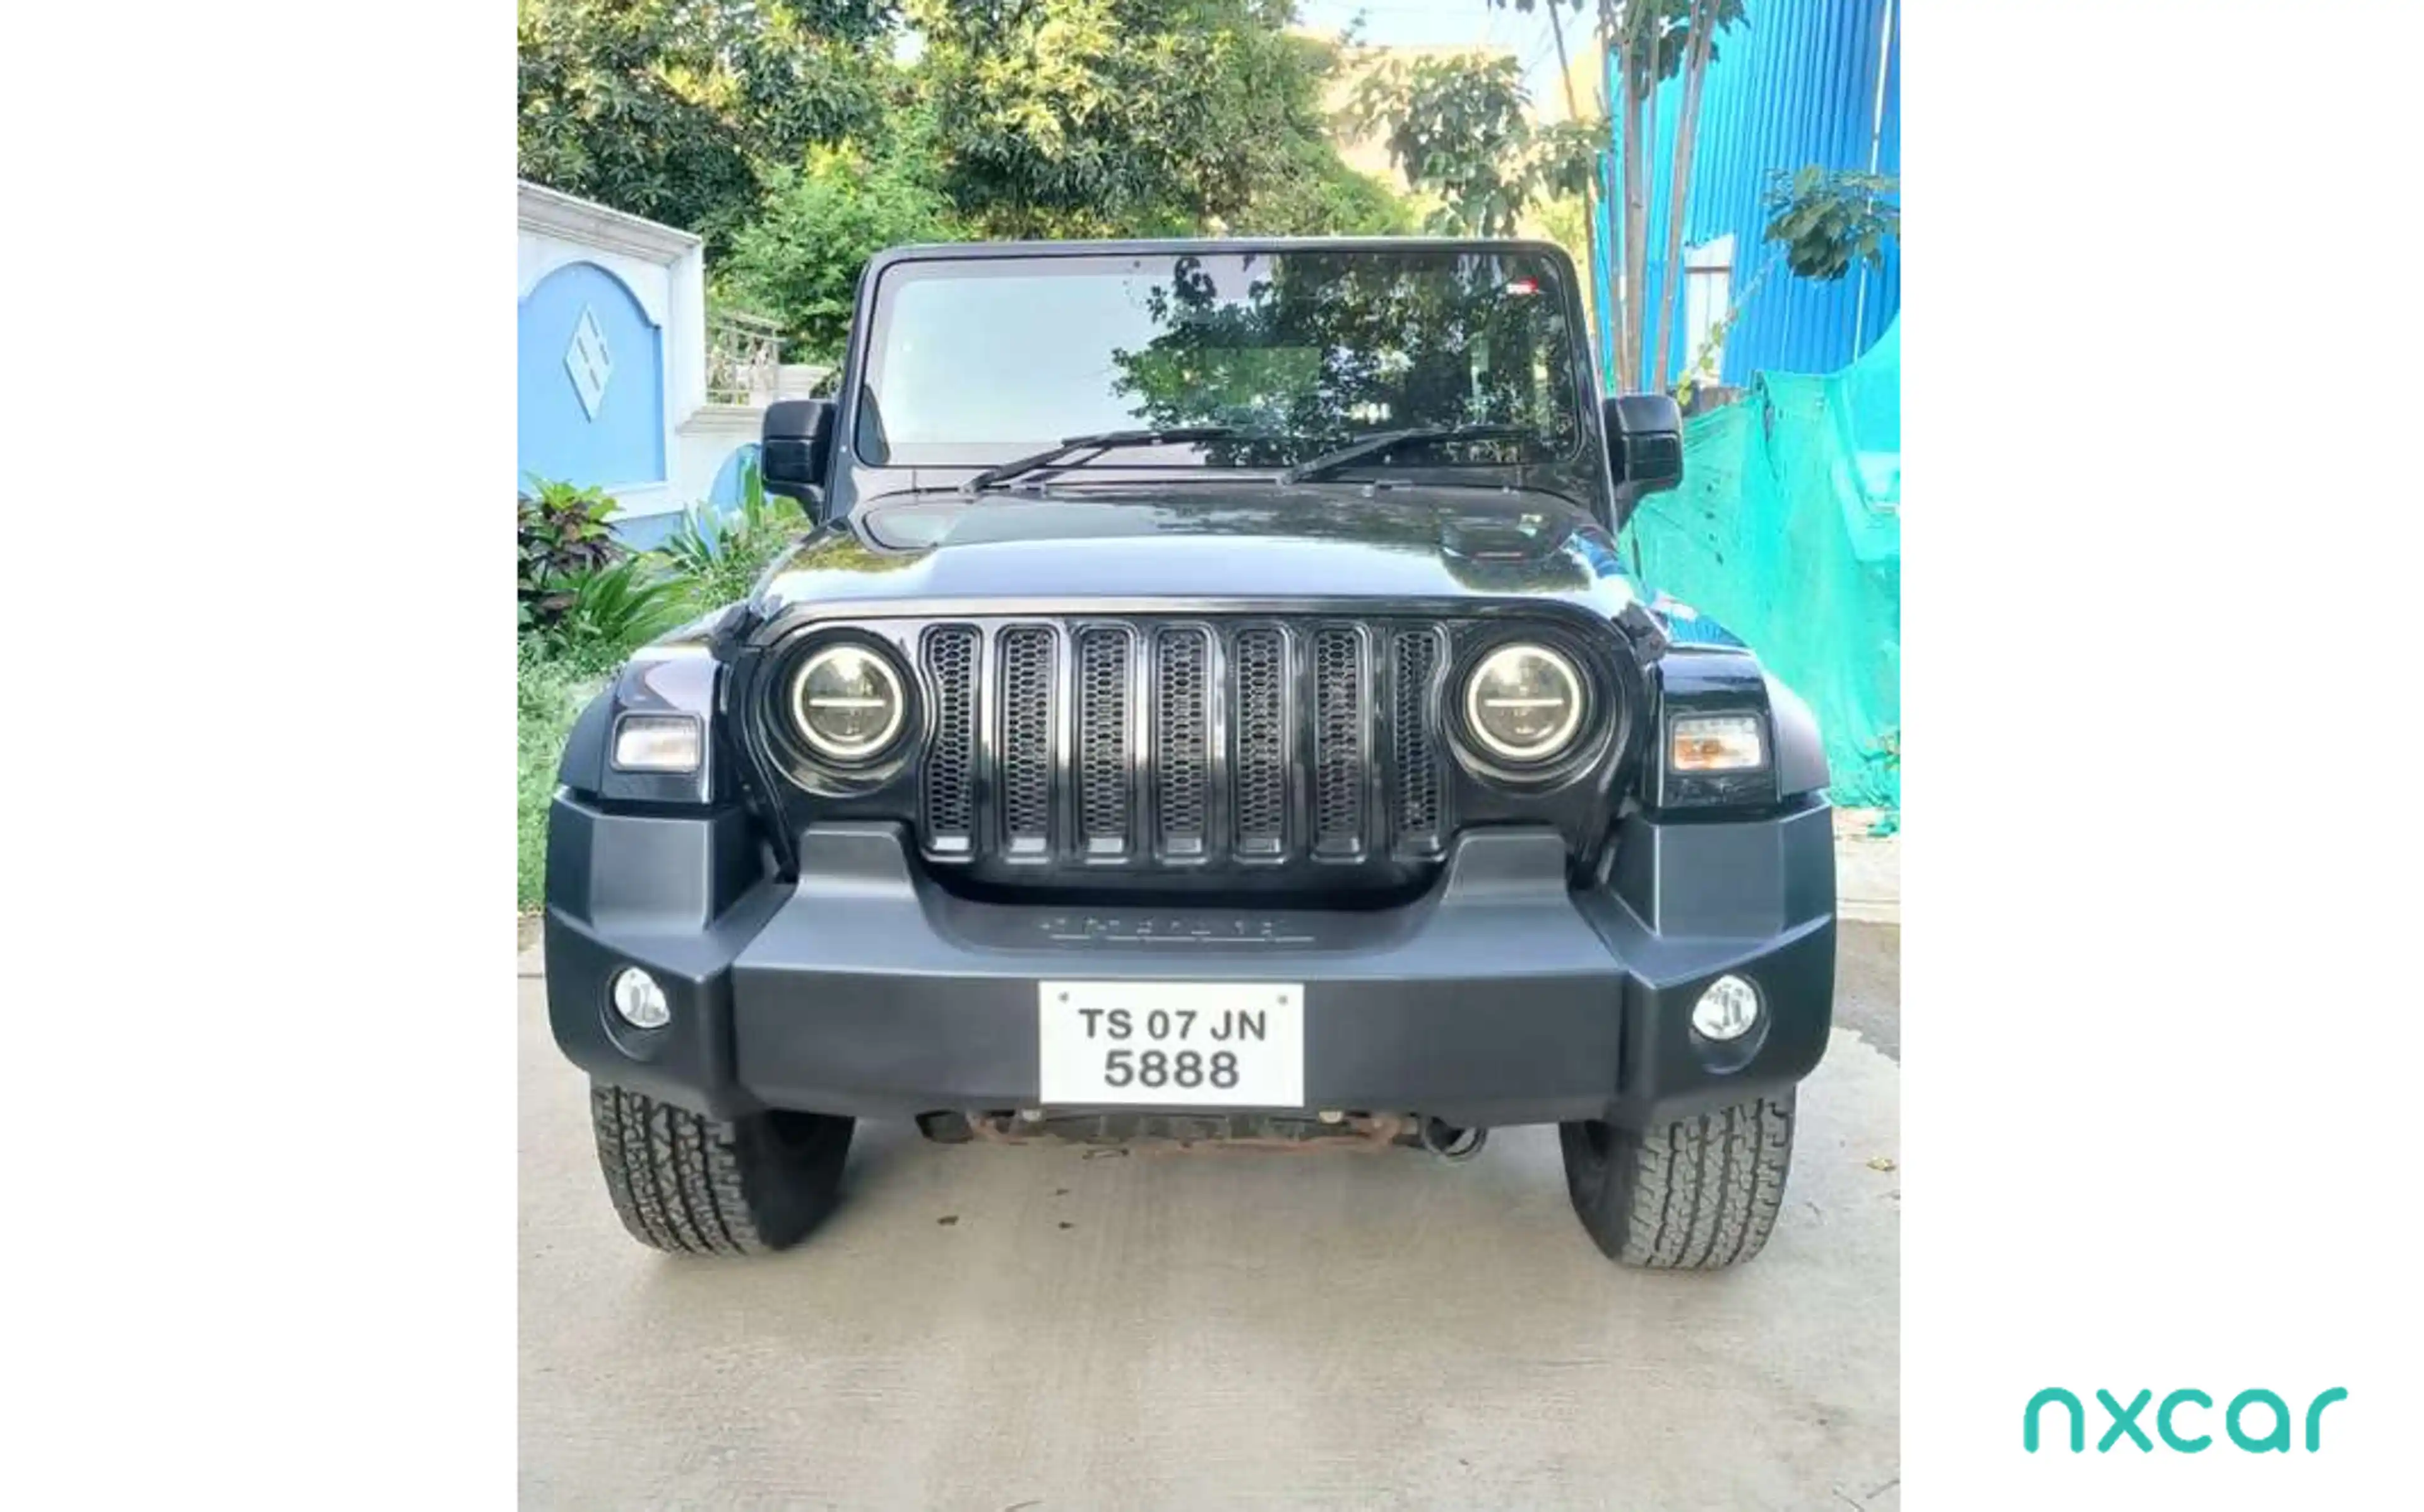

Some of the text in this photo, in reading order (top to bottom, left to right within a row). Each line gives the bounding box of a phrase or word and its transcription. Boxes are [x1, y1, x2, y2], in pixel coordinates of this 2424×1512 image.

[1078, 1008, 1266, 1041] TS 07 JN
[1104, 1049, 1239, 1089] 5888
